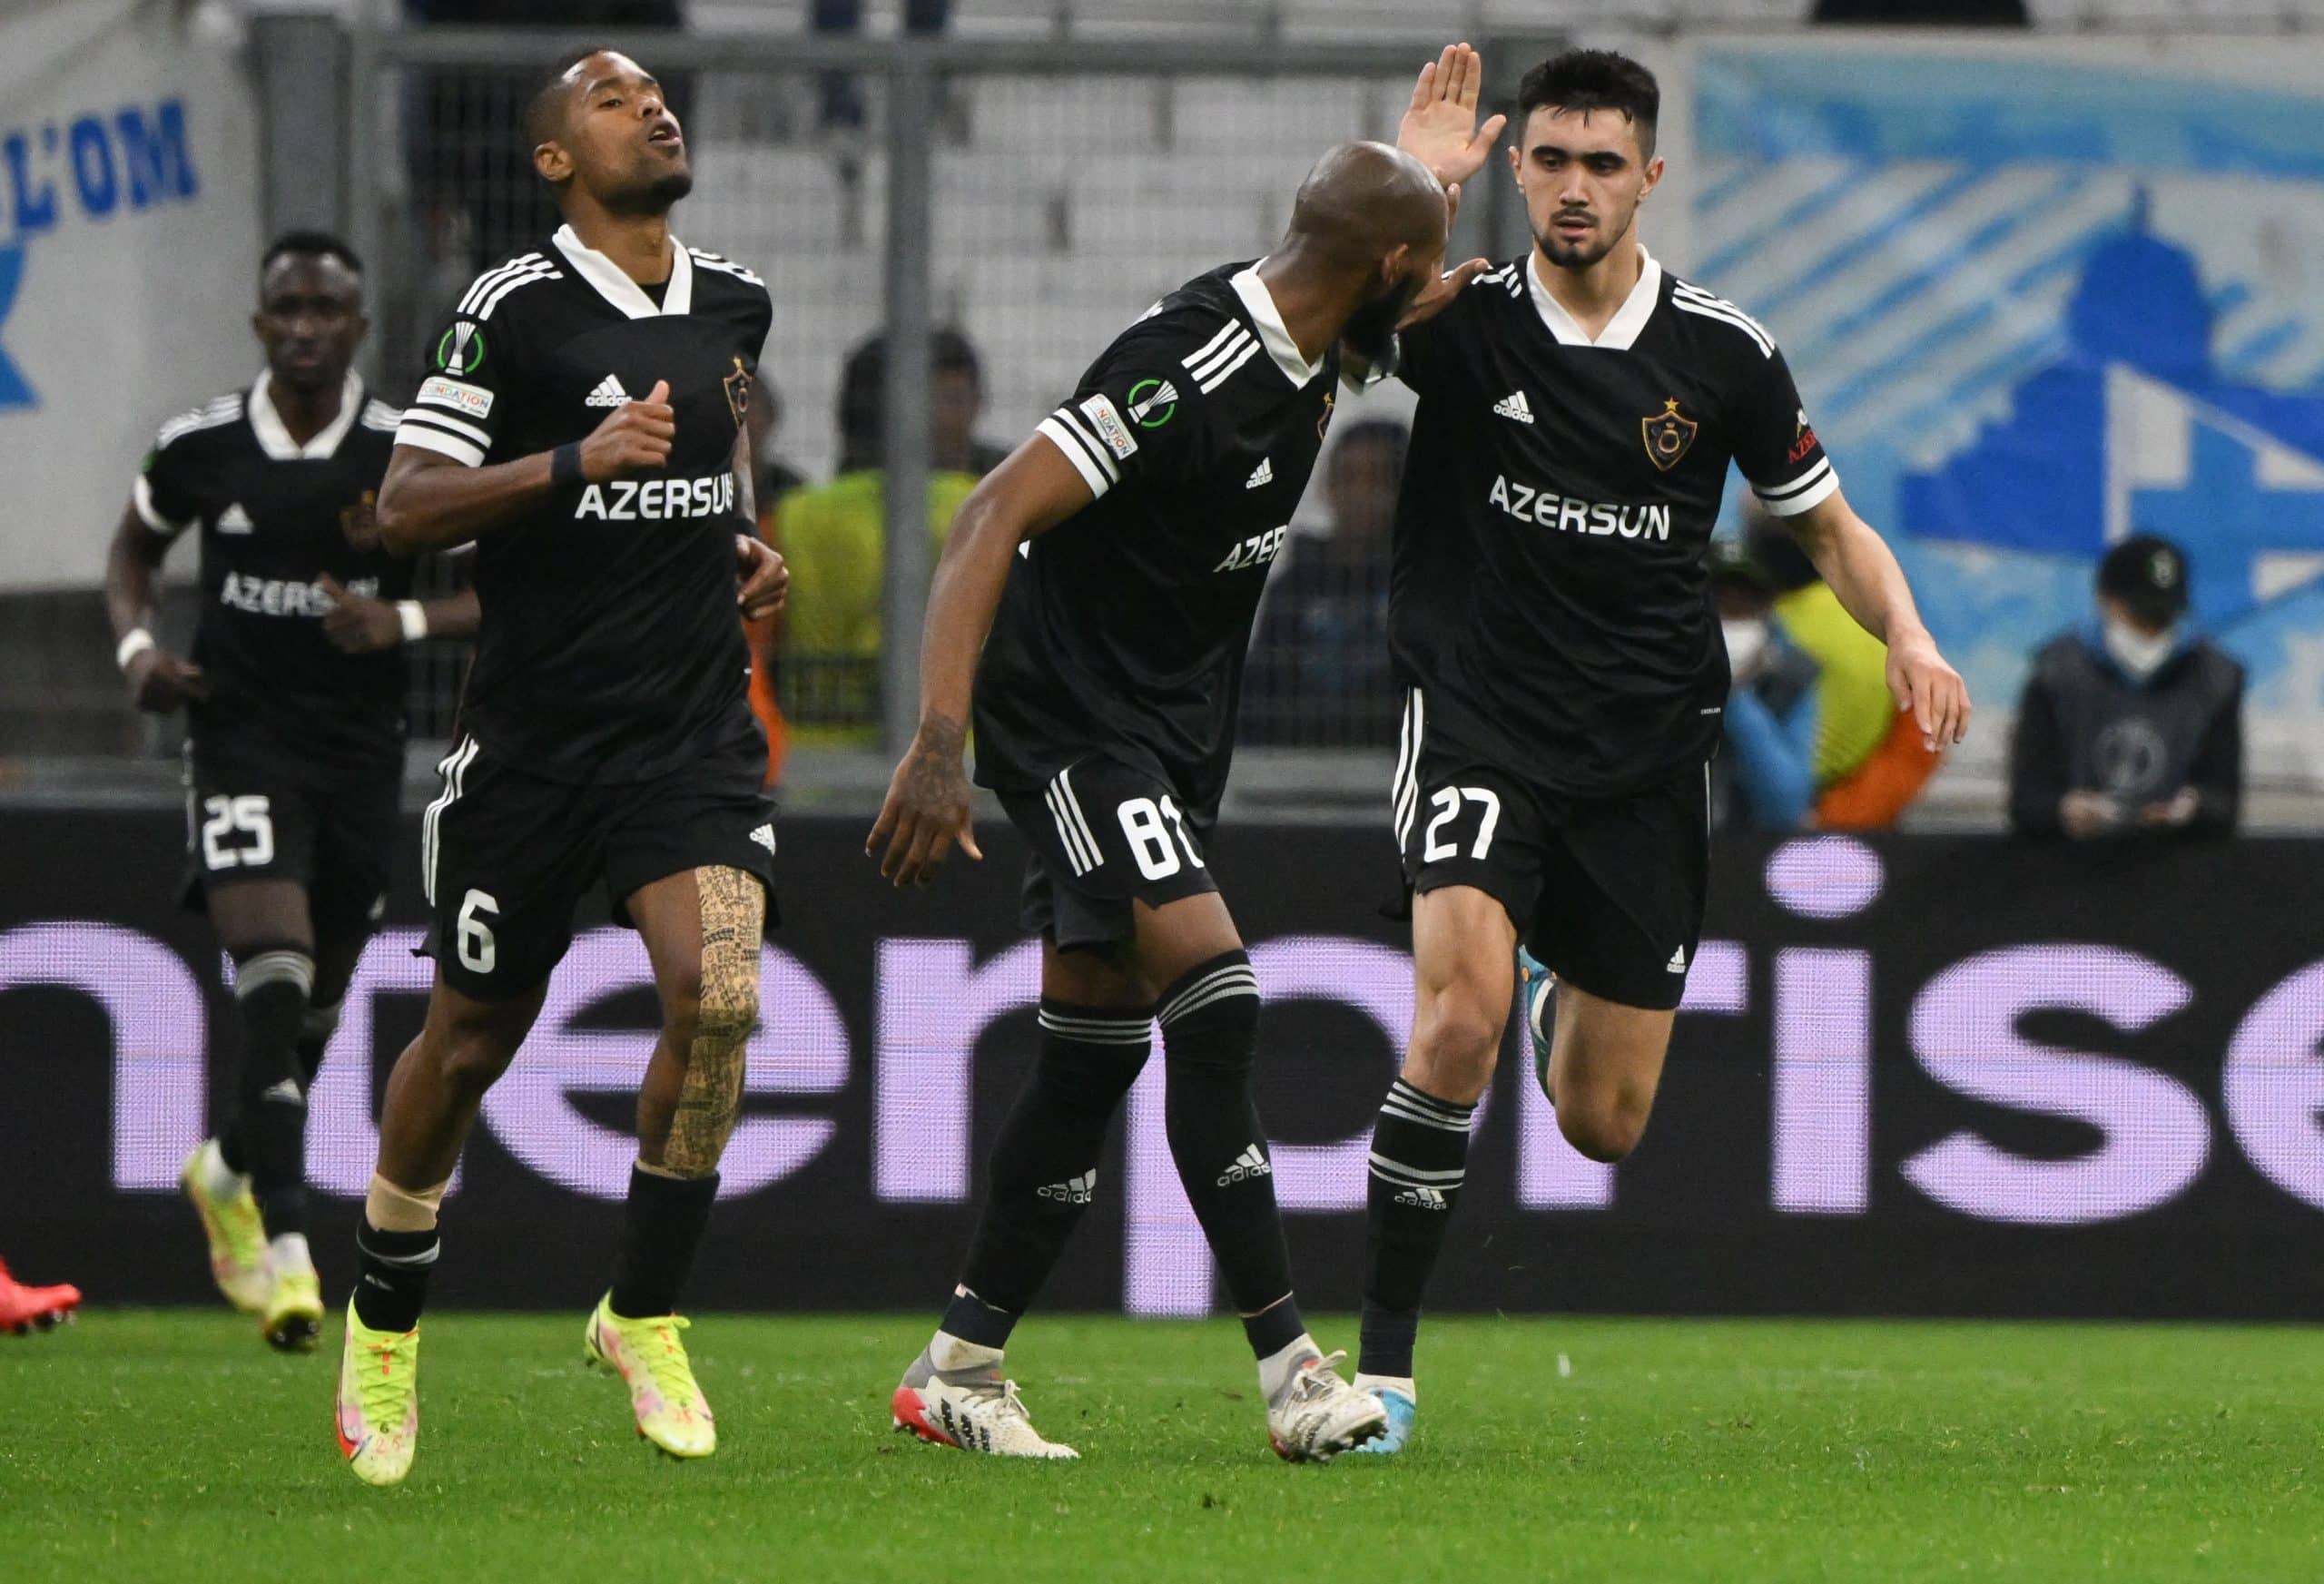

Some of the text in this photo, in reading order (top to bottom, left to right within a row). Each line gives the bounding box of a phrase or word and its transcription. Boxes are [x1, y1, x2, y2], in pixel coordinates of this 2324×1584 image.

[1493, 404, 1534, 424] adidas
[1489, 474, 1670, 541] AZERSUN
[202, 793, 274, 871] 25
[1423, 785, 1501, 863] 27
[458, 888, 500, 974] 6
